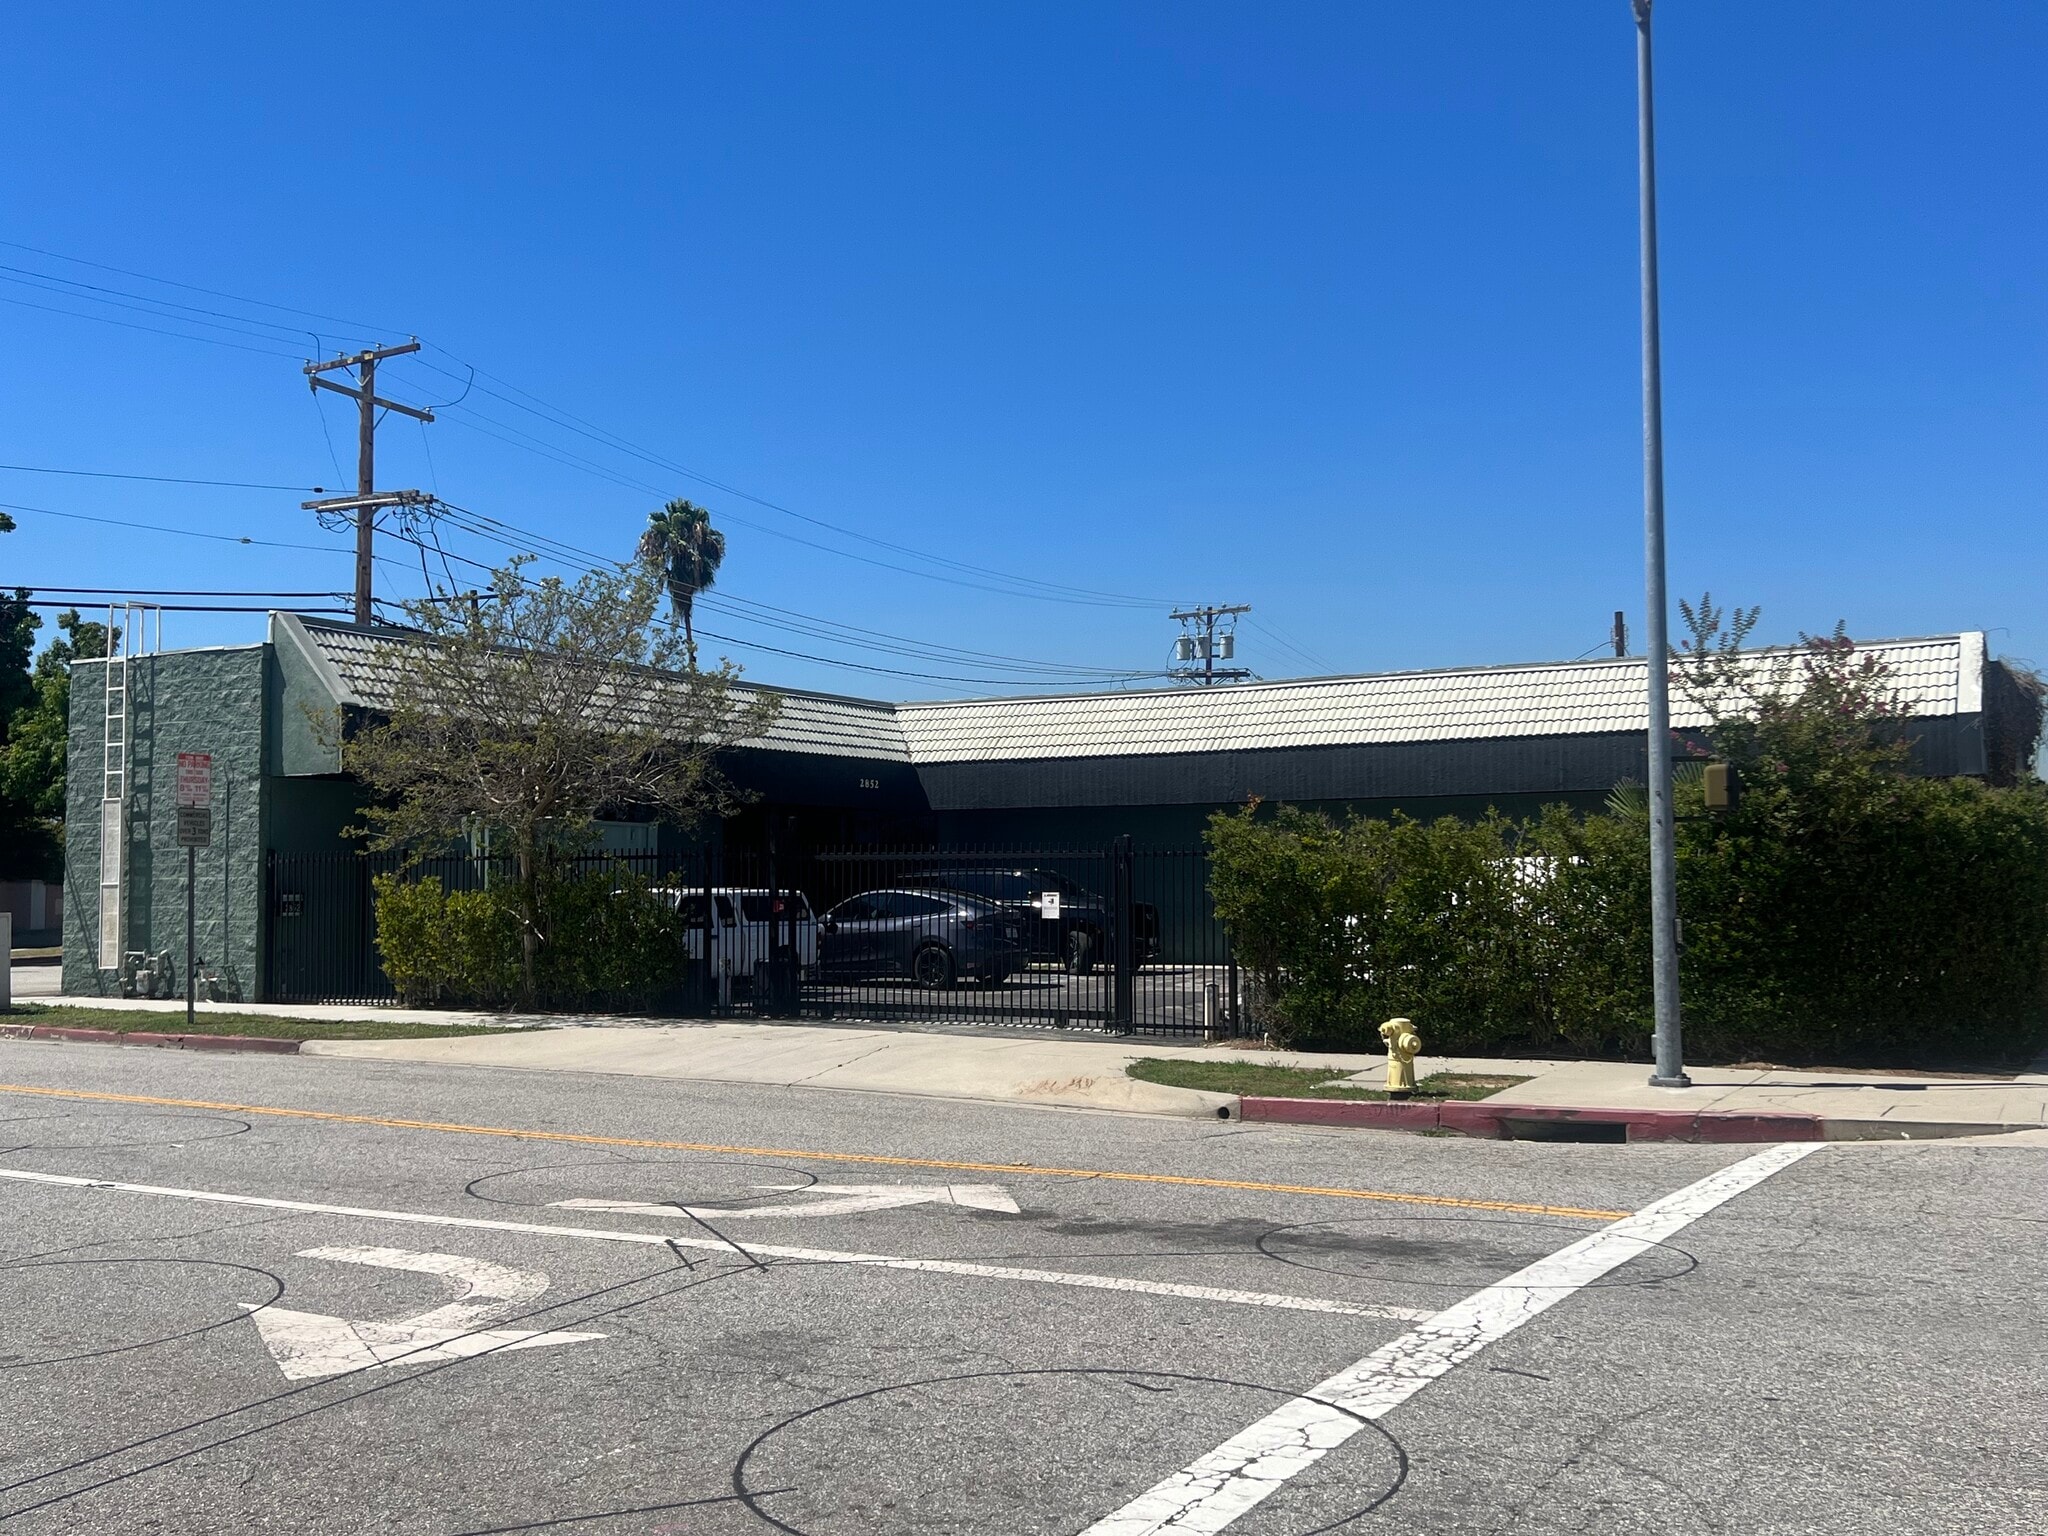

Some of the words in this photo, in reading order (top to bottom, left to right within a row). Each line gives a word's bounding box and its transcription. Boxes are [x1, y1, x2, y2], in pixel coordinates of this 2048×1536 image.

[179, 760, 187, 768] NO
[187, 761, 209, 769] PARKING
[180, 776, 209, 784] THURSDAY
[859, 778, 880, 789] 2852
[180, 784, 185, 792] 8
[195, 785, 202, 793] 11
[180, 811, 209, 819] COMMERCIAL
[191, 826, 197, 836] 3
